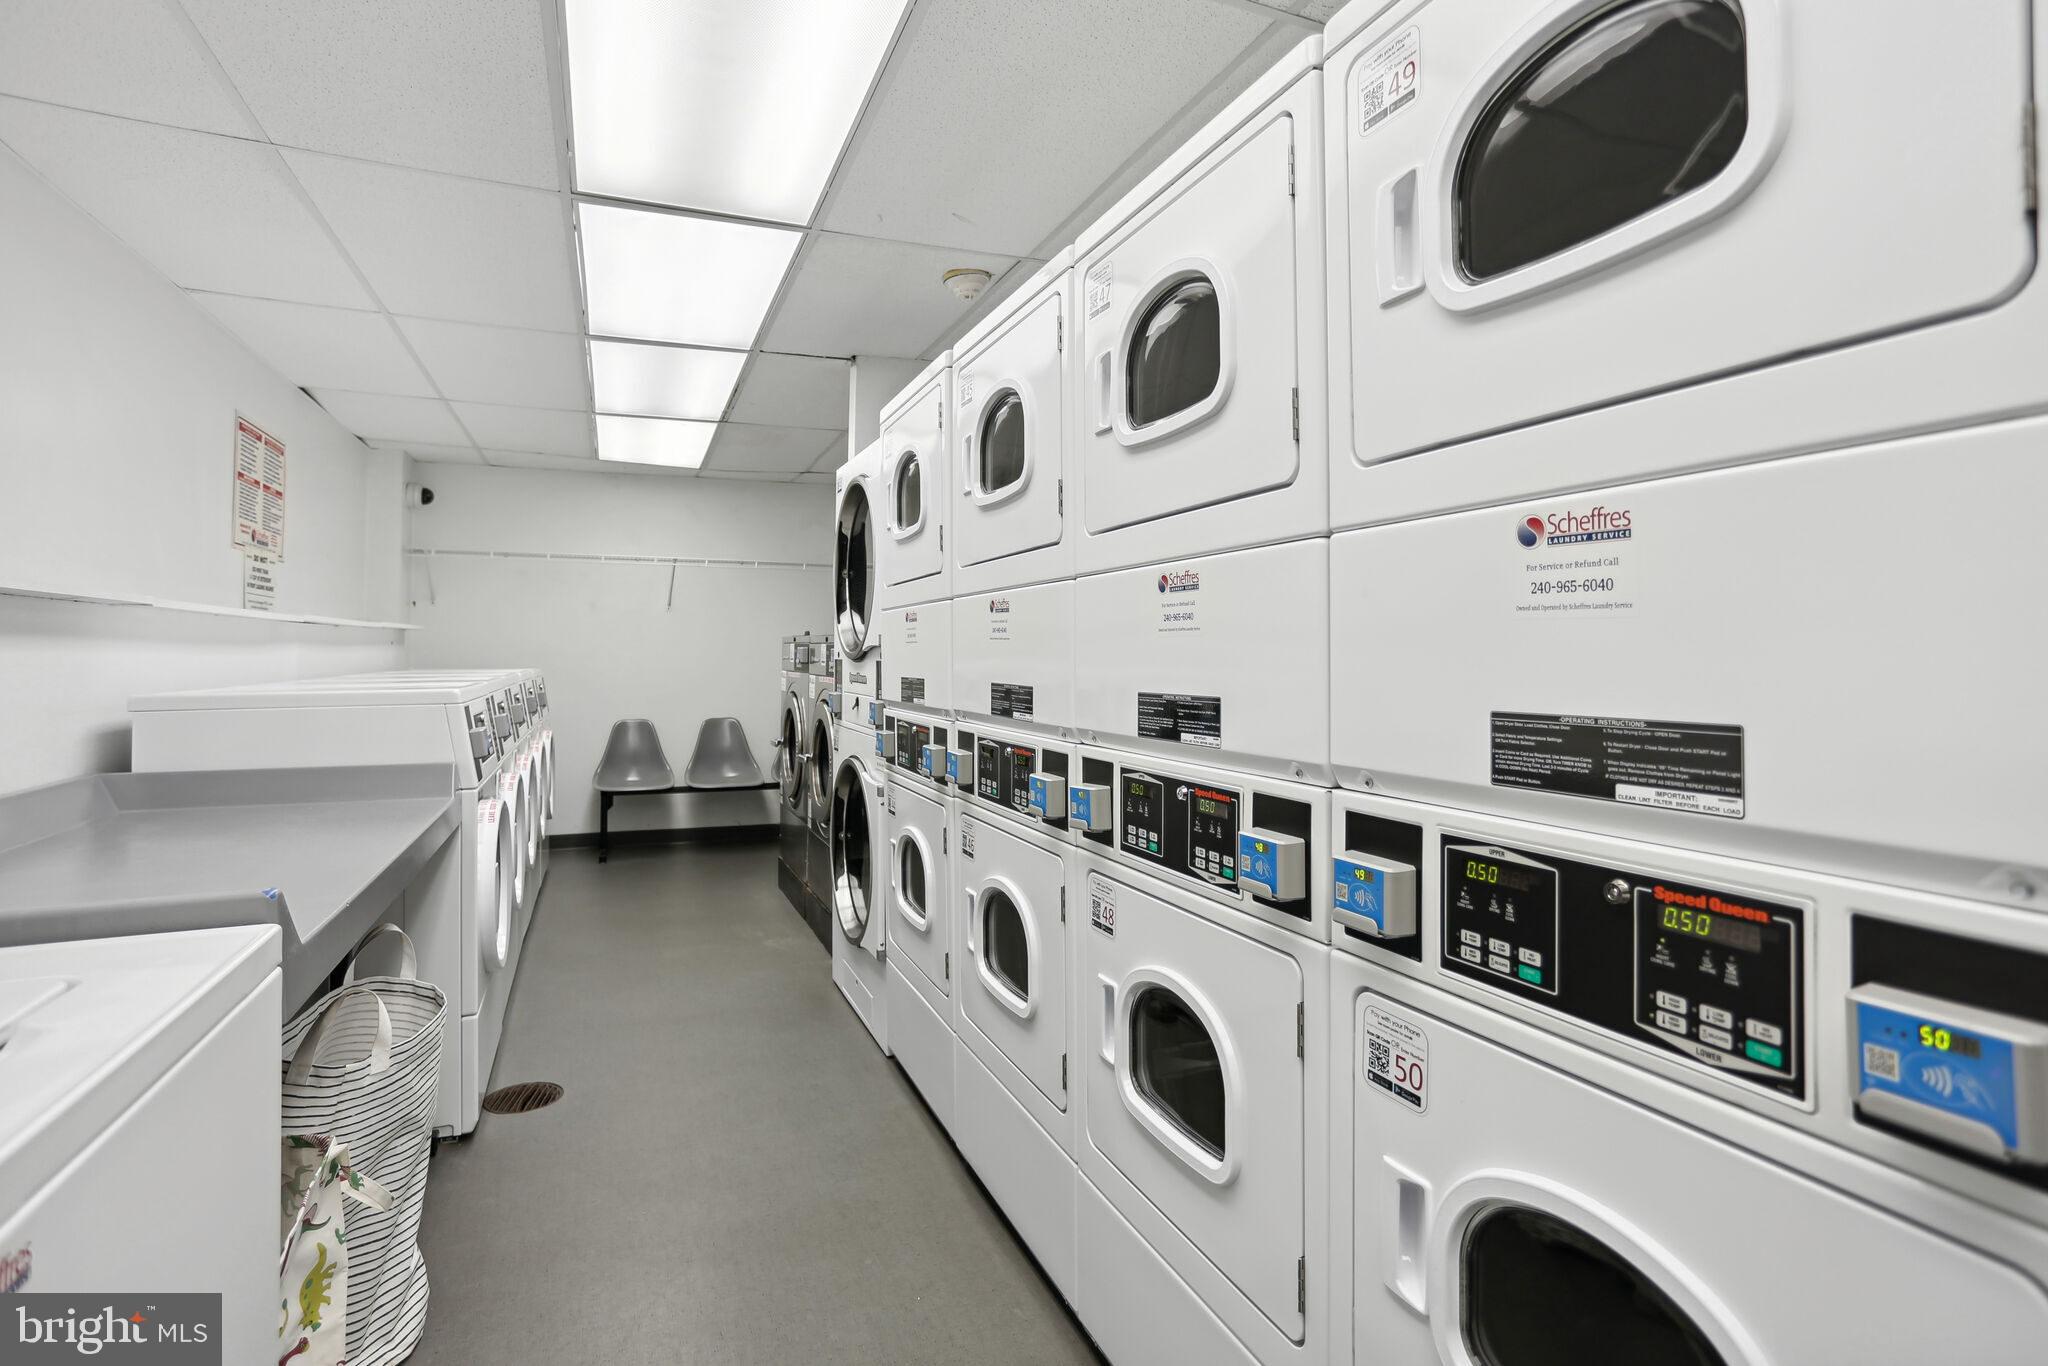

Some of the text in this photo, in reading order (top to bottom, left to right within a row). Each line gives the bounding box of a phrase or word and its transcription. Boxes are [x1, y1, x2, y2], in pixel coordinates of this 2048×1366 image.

[1388, 60, 1416, 96] 49
[1548, 506, 1631, 535] Scheffres
[1548, 530, 1631, 545] LAUNDRY SERVICE
[1526, 564, 1538, 572] For
[1539, 562, 1563, 572] Service
[1574, 558, 1602, 568] Refund
[1604, 557, 1619, 566] Call
[1168, 570, 1200, 586] Scheffres
[1530, 578, 1614, 594] 240-965-6040
[1654, 790, 1698, 802] IMPORTANT:
[1676, 801, 1700, 810] BEFORE
[1703, 804, 1720, 812] EACH
[1723, 807, 1741, 816] LOAD
[1489, 848, 1506, 858] UPPER
[1354, 868, 1365, 880] 49
[1466, 861, 1498, 883] 0.50
[1653, 886, 1770, 924] Speed Queen
[1102, 906, 1114, 926] 48
[1663, 907, 1711, 936] 0.50
[1370, 1010, 1380, 1020] Pay
[1380, 1016, 1390, 1024] with
[1404, 1024, 1420, 1038] Phone
[1919, 1024, 1950, 1050] 50
[1696, 1046, 1722, 1064] LOWER
[1394, 1054, 1423, 1092] 50
